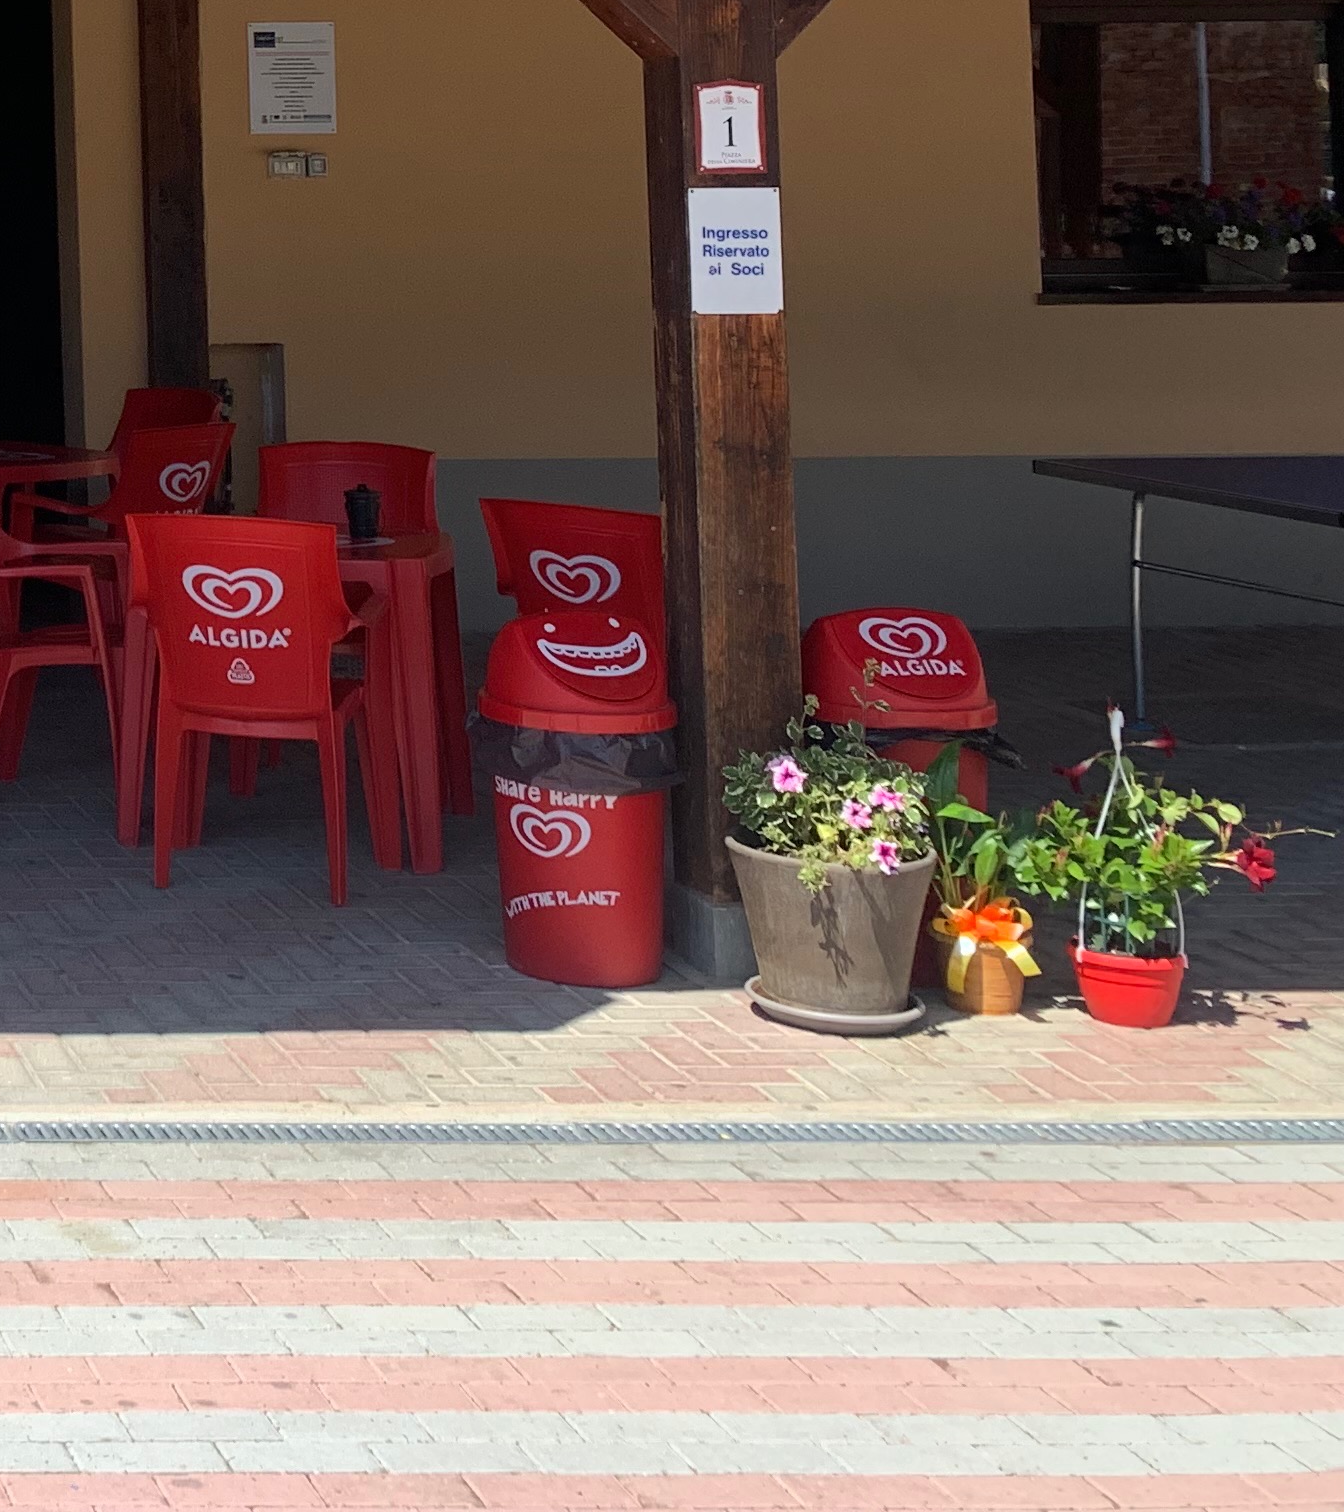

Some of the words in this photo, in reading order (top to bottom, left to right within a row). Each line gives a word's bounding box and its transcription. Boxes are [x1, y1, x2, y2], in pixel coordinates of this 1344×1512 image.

[723, 116, 738, 148] 1
[702, 227, 768, 242] Ingresso
[702, 244, 770, 258] Riservato
[708, 263, 721, 276] ai
[730, 263, 765, 276] Soci
[189, 623, 289, 649] ALGIDA
[880, 659, 967, 677] ALGIDA
[555, 890, 621, 906] PLANET
